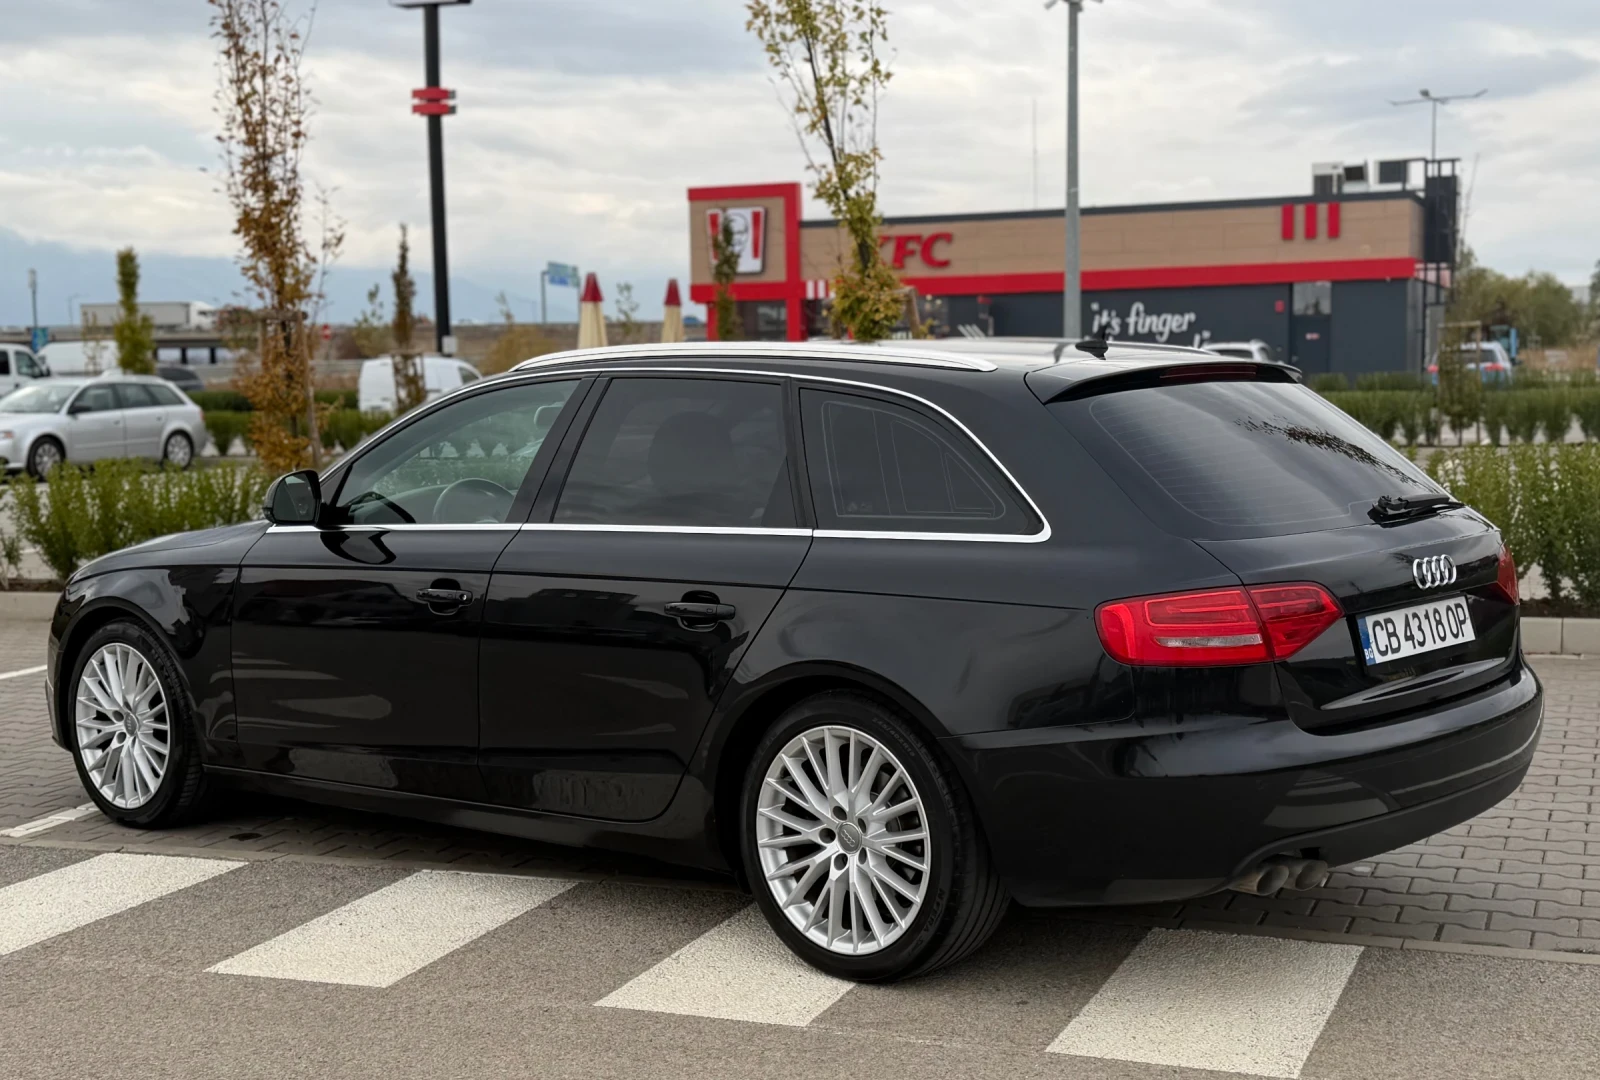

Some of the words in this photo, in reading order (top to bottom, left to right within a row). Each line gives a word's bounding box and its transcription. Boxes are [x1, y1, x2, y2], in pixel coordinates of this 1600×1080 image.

[1125, 301, 1196, 343] finger
[1372, 616, 1401, 656] CB
[1404, 608, 1446, 649] 4318
[1446, 603, 1467, 639] OP
